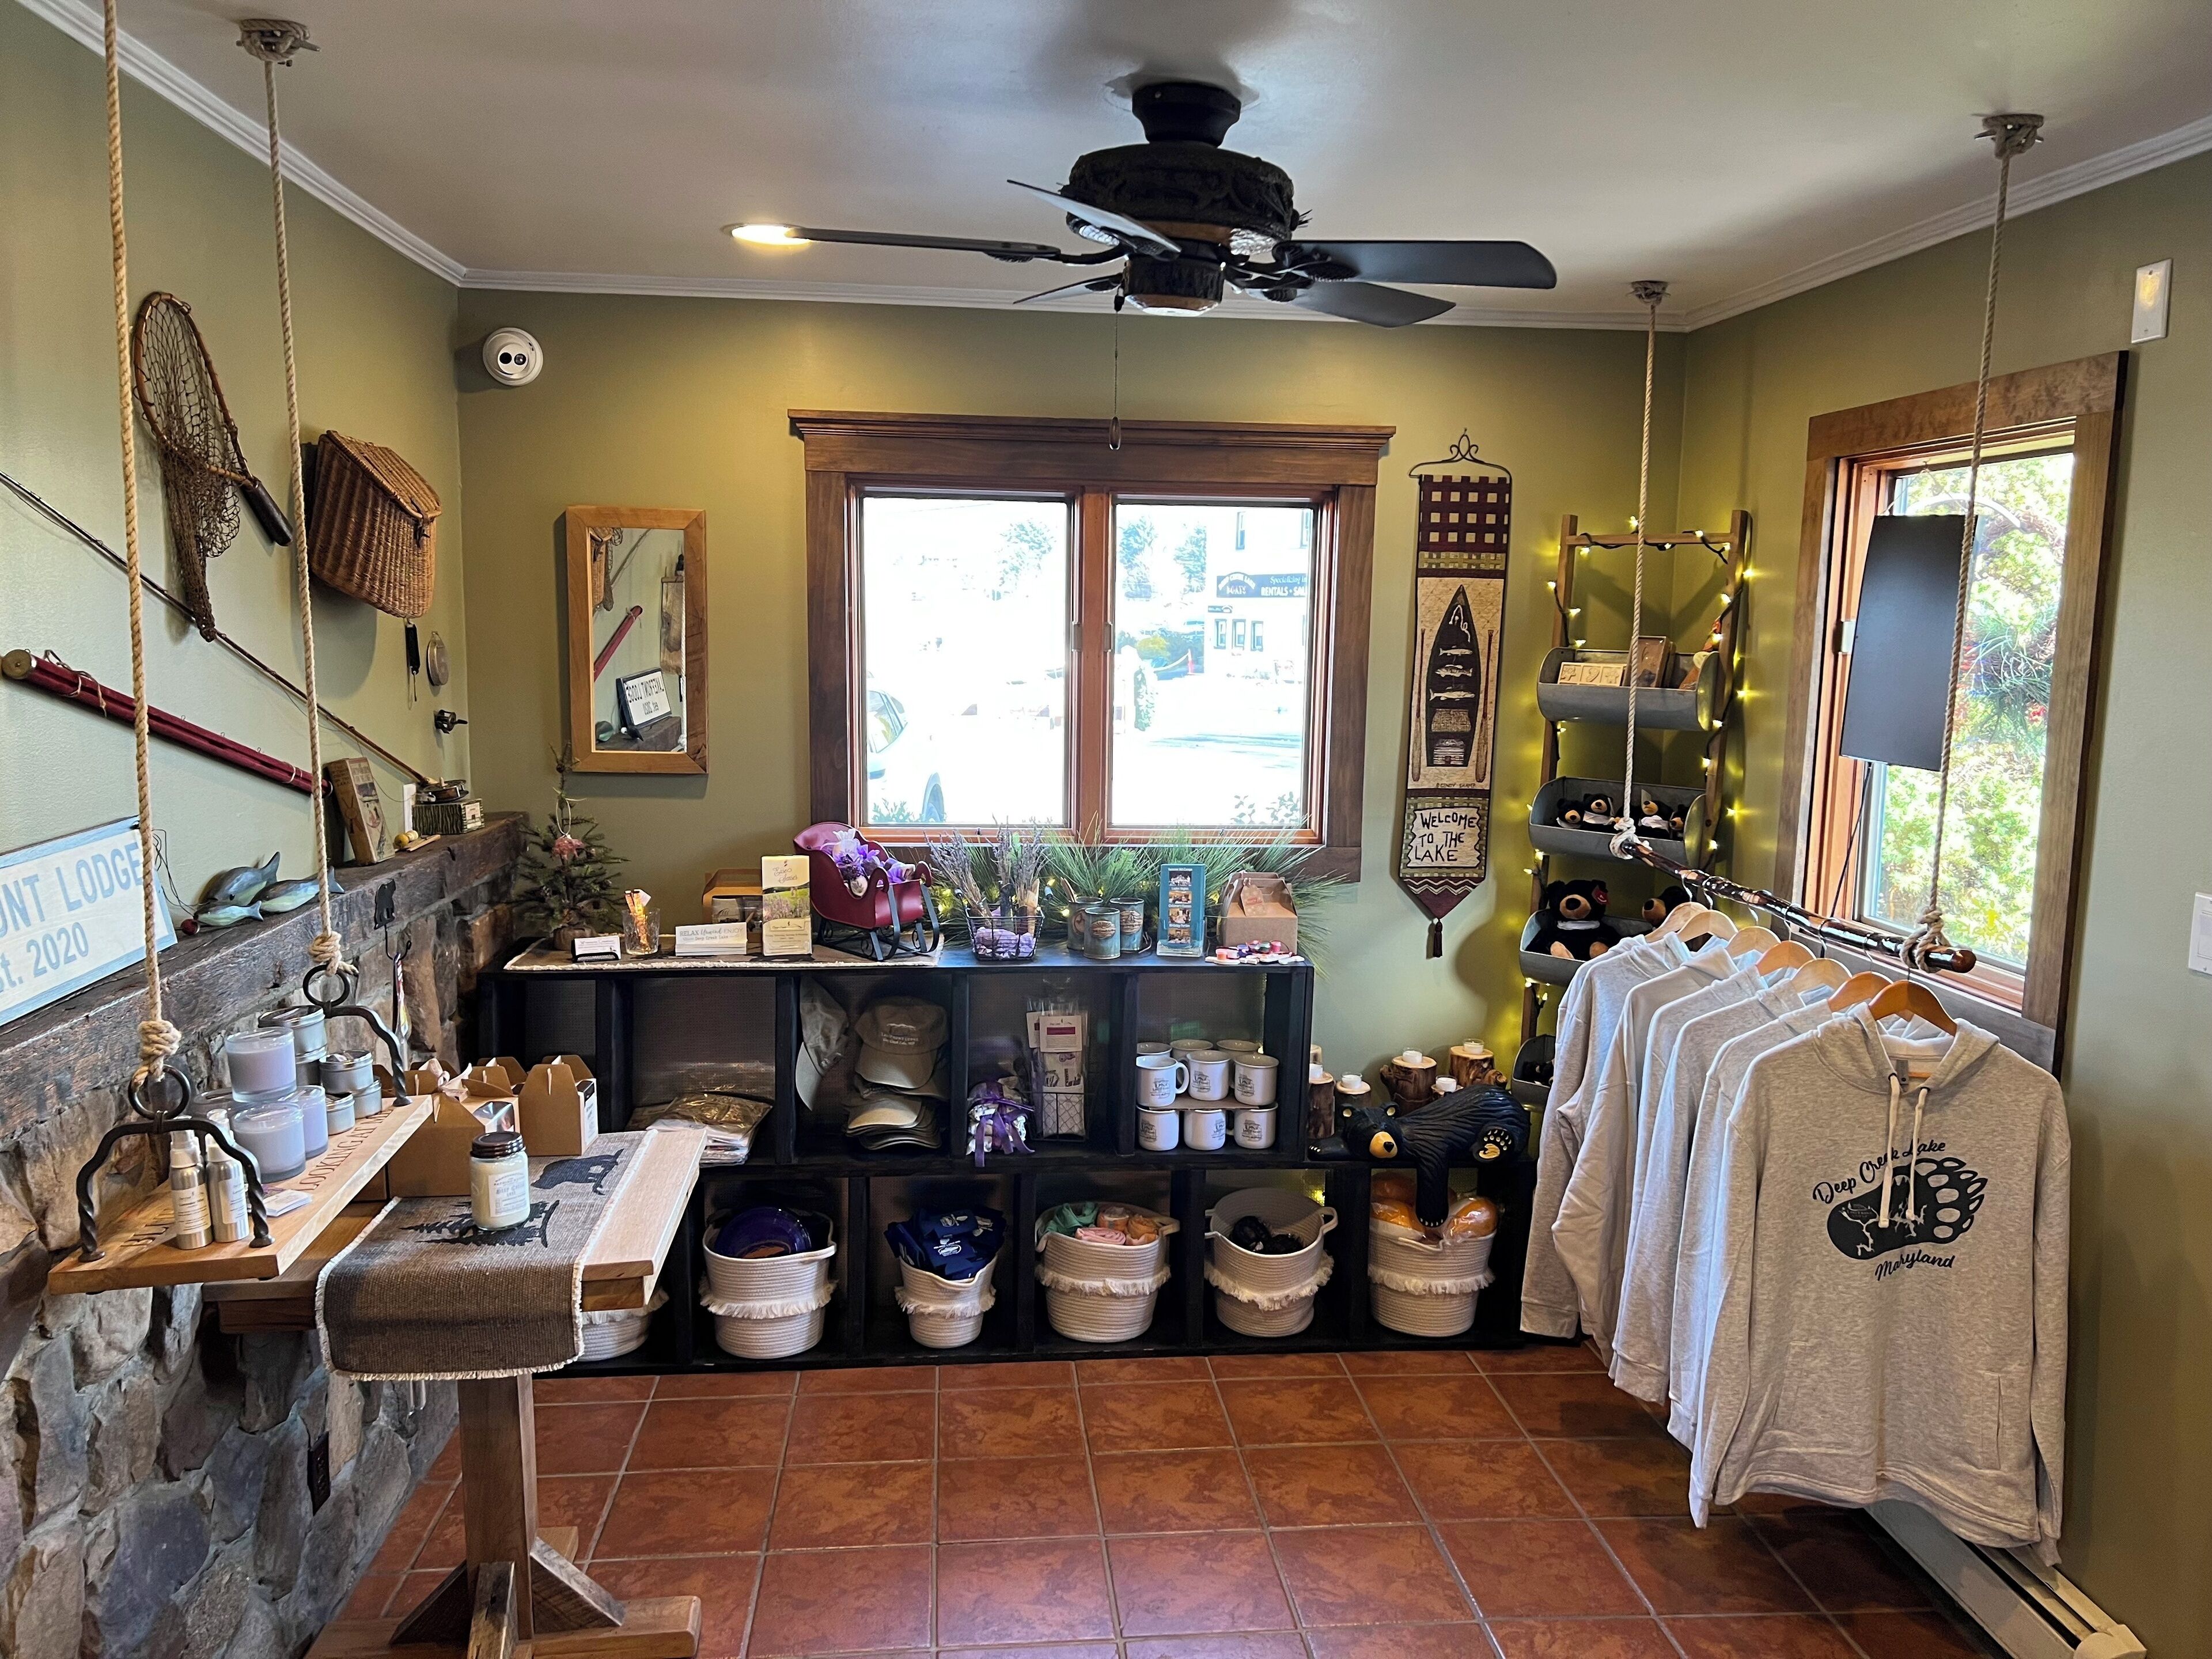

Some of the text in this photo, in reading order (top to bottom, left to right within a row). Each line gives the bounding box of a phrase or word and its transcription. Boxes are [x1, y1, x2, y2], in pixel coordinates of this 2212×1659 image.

[1261, 586, 1289, 596] RENTALS
[1421, 812, 1477, 830] WELCOME
[1415, 844, 1458, 862] LAKE
[1418, 831, 1465, 848] TO THE
[55, 842, 143, 912] LODGE
[26, 922, 89, 978] 2020
[290, 1140, 363, 1191] LOOKING
[1813, 1177, 1857, 1204] Deep
[1902, 1138, 1946, 1157] Lake
[1874, 1249, 1956, 1281] Maryland
